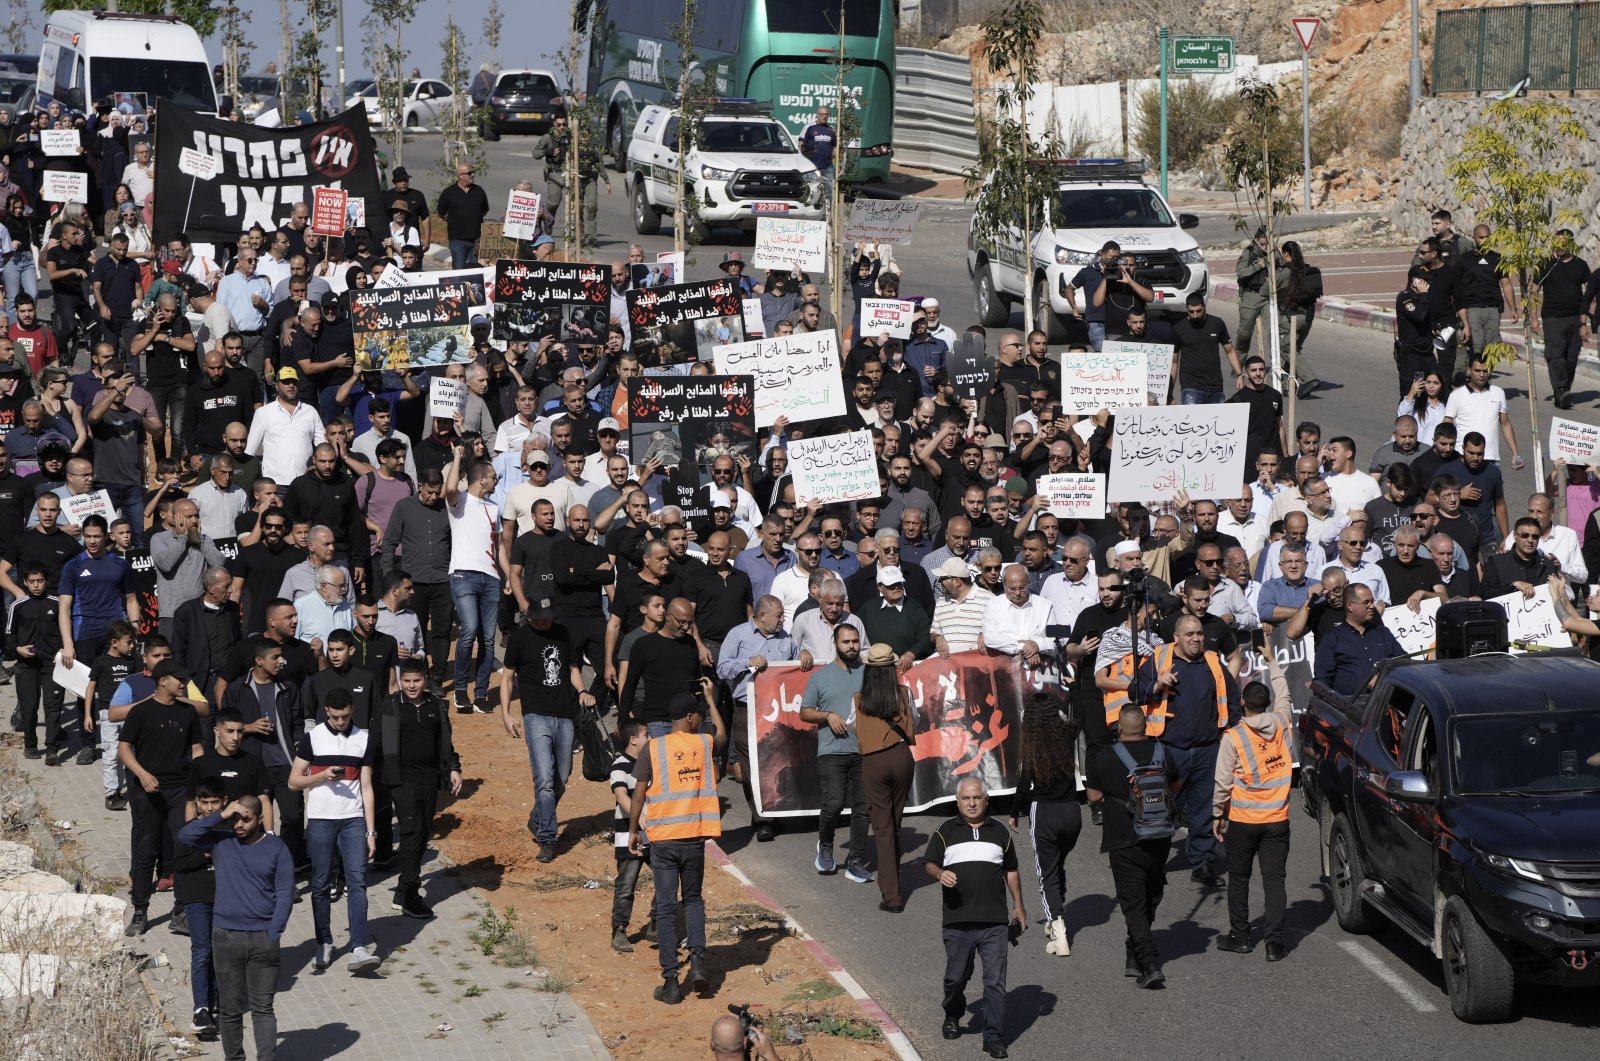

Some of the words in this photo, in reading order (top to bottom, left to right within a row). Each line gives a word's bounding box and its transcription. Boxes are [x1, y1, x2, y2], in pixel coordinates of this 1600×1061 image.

[1182, 42, 1210, 53] البستان
[314, 135, 353, 168] אין
[318, 197, 343, 208] NOW
[485, 237, 516, 247] ETHNIC
[548, 267, 577, 282] المذابح
[578, 269, 604, 283] أوقفوا
[403, 287, 434, 304] المذابح
[436, 284, 465, 300] أوقفوا
[521, 286, 536, 300] رفح
[538, 287, 550, 302] في
[573, 291, 587, 300] ضد
[678, 287, 706, 303] المذابح
[707, 282, 733, 298] أوقفوا
[705, 306, 720, 316] ضد
[900, 304, 911, 312] אין
[376, 312, 393, 329] رفح
[395, 311, 408, 328] في
[433, 310, 448, 322] ضد
[655, 311, 670, 326] رفح
[672, 309, 684, 325] في
[867, 318, 893, 328] عسكري
[965, 357, 976, 368] די
[955, 369, 990, 385] לכיבוש
[686, 384, 717, 399] المذابح
[719, 382, 747, 397] أوقفوا
[658, 405, 674, 421] رفح
[676, 405, 690, 422] في
[714, 406, 730, 418] ضد
[677, 485, 694, 497] Stop
[680, 496, 693, 506] the
[1076, 500, 1091, 508] צדק
[683, 506, 708, 520] pation
[678, 774, 701, 783] סדרן
